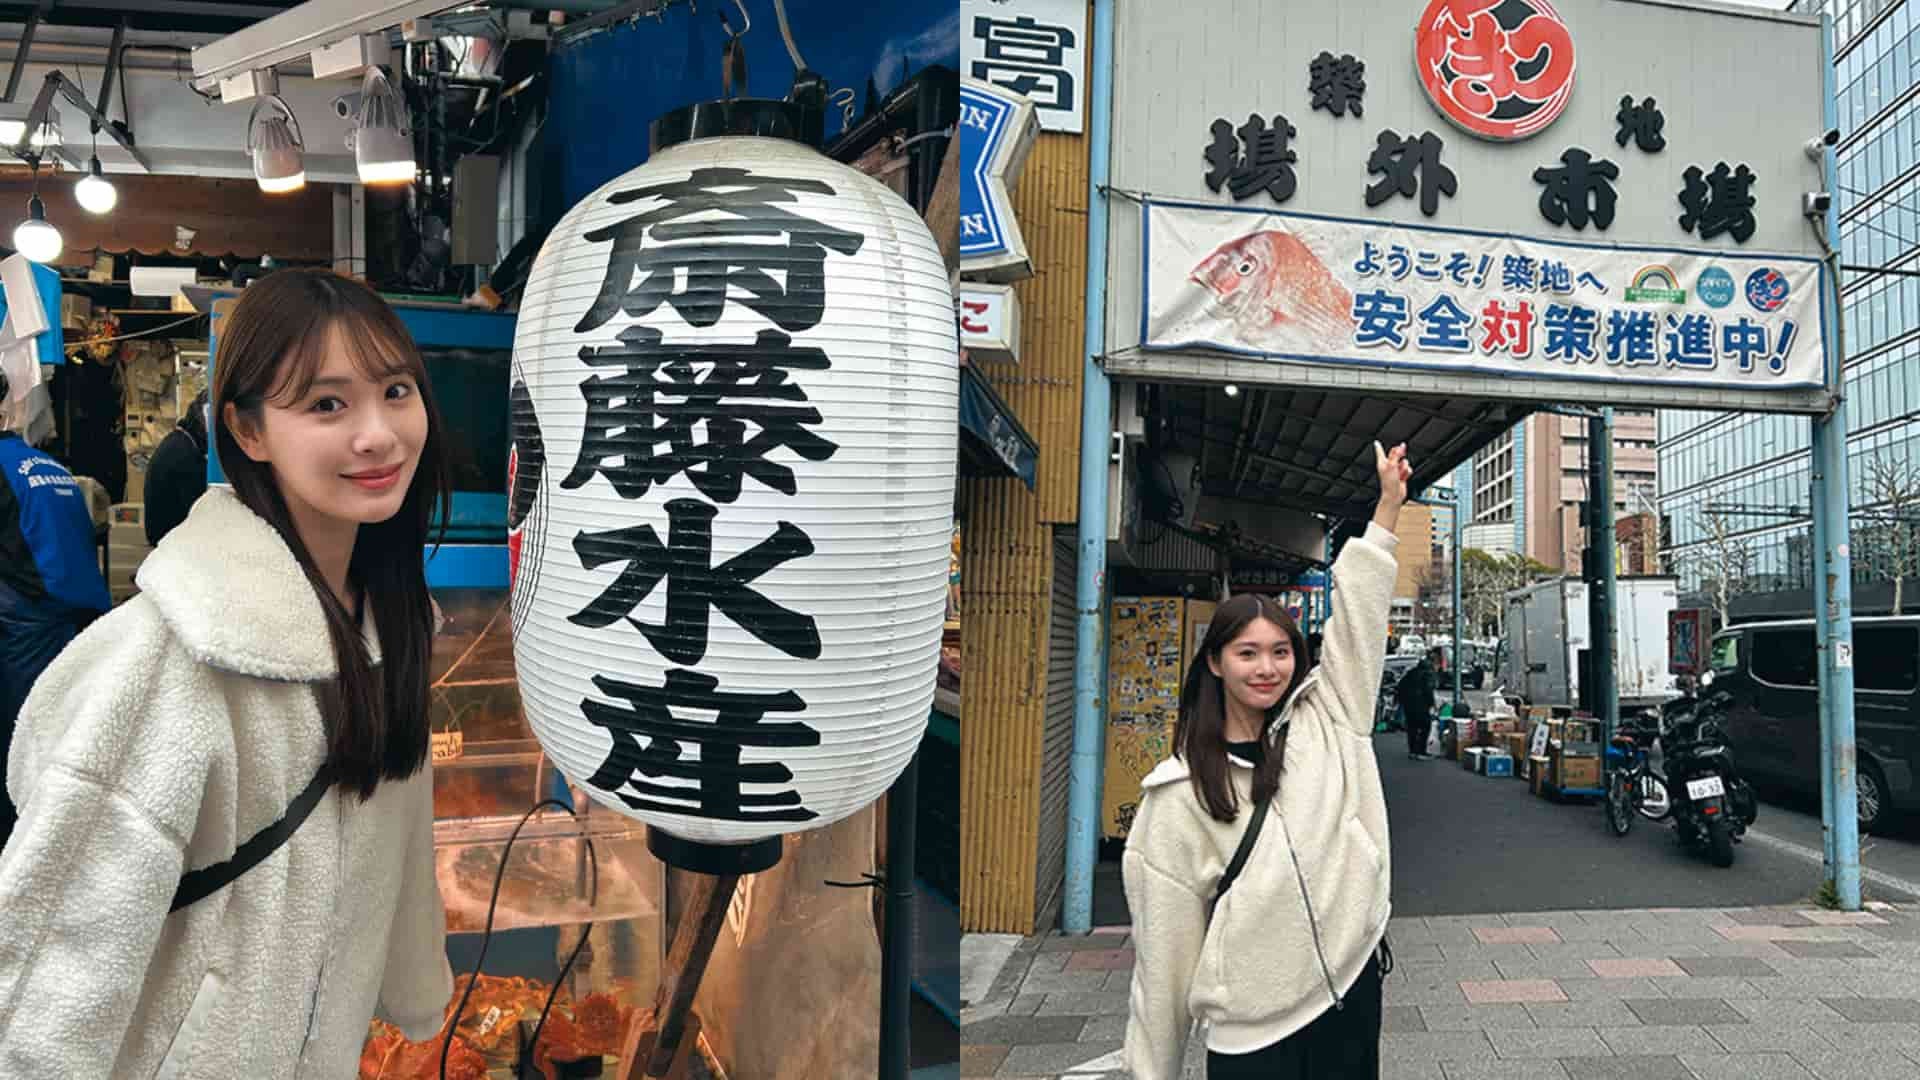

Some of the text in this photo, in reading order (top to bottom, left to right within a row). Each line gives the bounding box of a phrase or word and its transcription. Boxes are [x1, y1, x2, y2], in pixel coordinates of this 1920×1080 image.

[1353, 289, 1794, 370] 安全対策推進中!
